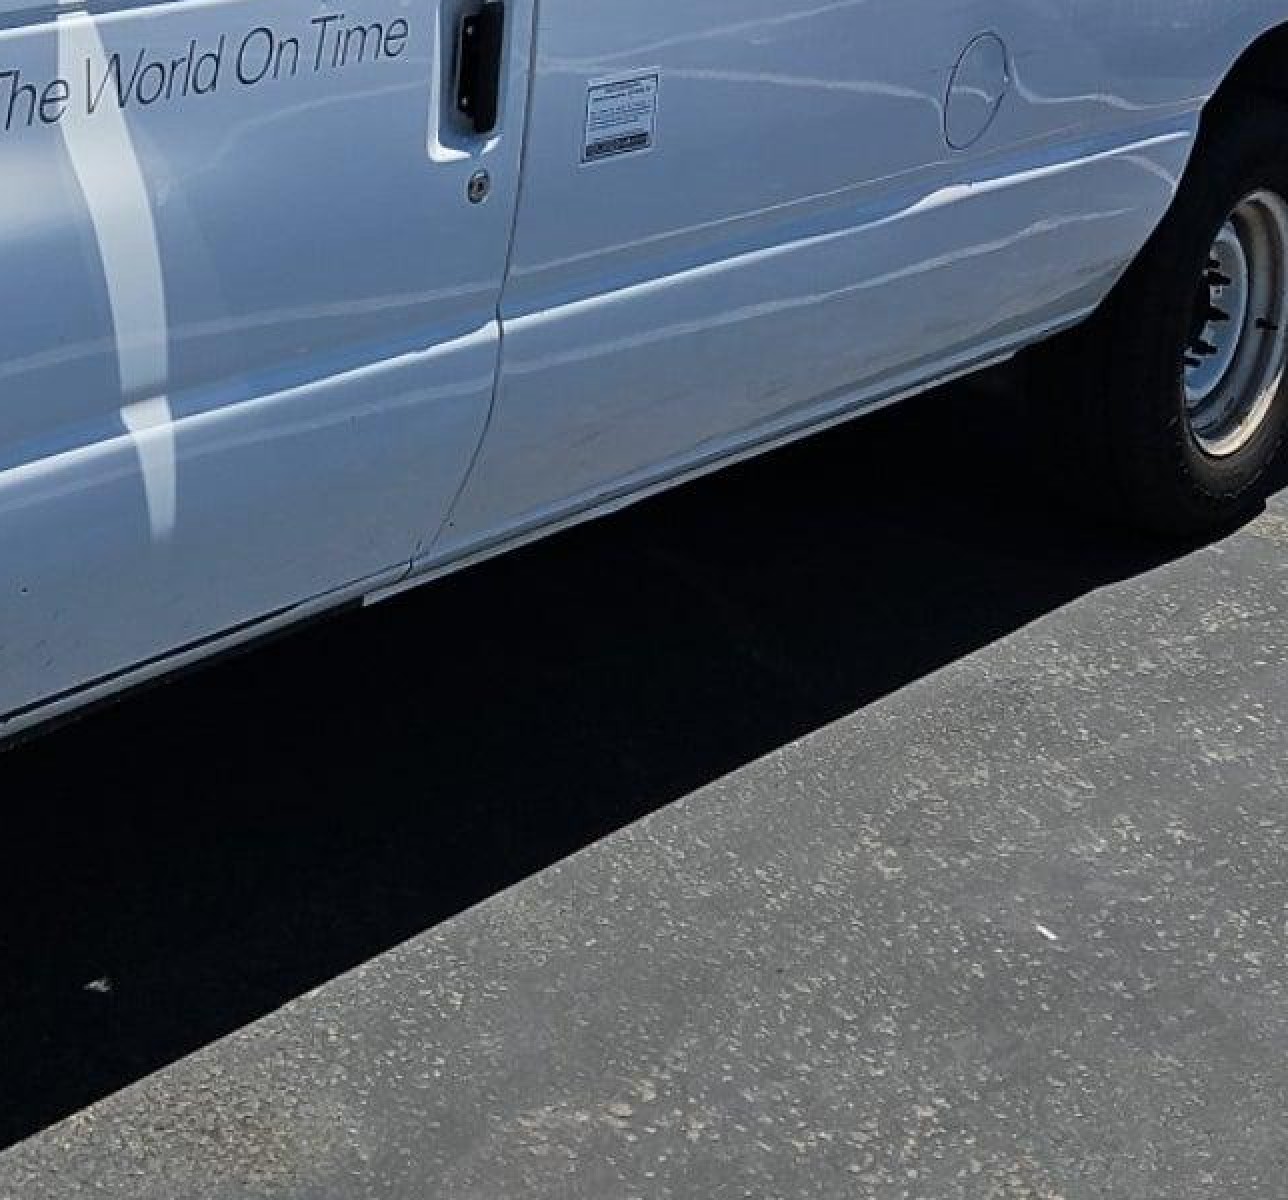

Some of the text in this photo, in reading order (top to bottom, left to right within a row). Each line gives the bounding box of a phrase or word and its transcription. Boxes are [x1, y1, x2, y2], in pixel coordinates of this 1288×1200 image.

[85, 34, 225, 114] World
[235, 27, 300, 86] On
[311, 13, 409, 72] Time
